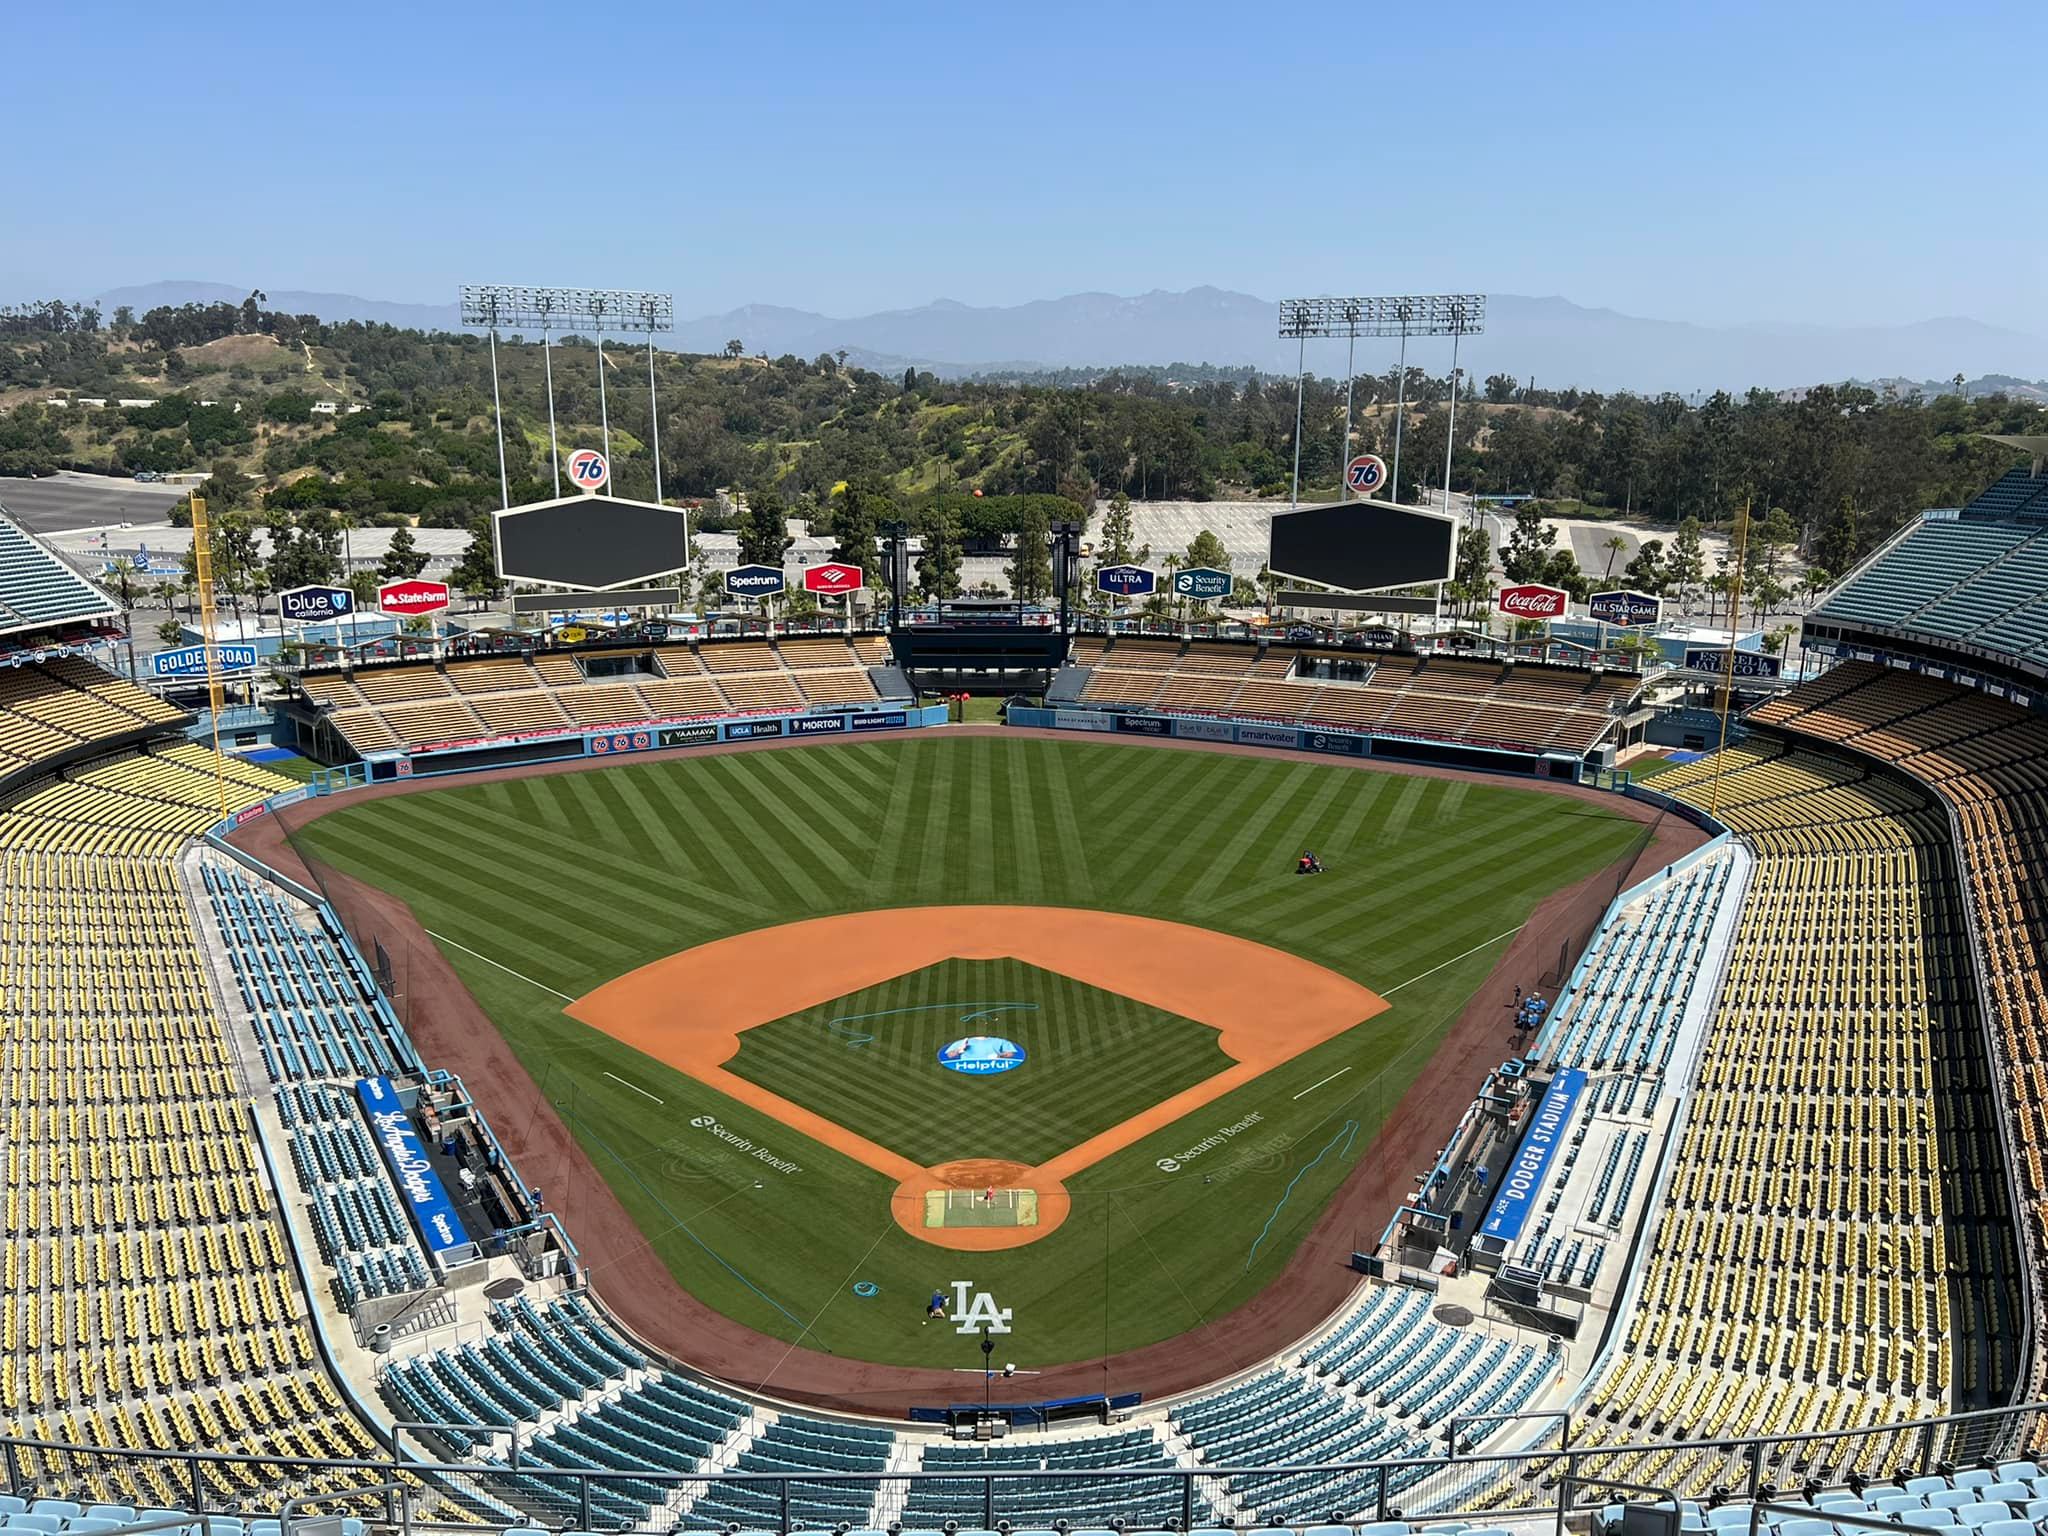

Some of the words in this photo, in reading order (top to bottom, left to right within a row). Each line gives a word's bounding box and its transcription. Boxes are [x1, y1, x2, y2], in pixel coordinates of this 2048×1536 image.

[576, 457, 604, 480] 76
[1352, 463, 1379, 485] 76
[729, 576, 777, 588] Spectrum
[1110, 575, 1142, 584] ULTRA
[1195, 575, 1226, 585] Security
[1195, 584, 1222, 592] Benefit
[288, 595, 328, 611] blue
[295, 609, 334, 618] california
[1631, 604, 1657, 615] GAME
[217, 650, 252, 664] ROAD
[1692, 660, 1752, 675] JALISCO
[802, 719, 841, 730] MORTON
[1124, 717, 1160, 728] Spectrum
[731, 727, 750, 735] UCLA
[753, 724, 778, 734] Health
[635, 736, 646, 744] 76
[1241, 728, 1296, 744] smartwater
[596, 740, 606, 749] 76
[615, 738, 627, 746] 76
[398, 763, 410, 772] 76
[955, 1061, 1009, 1071] Helpful
[1174, 1132, 1228, 1162] Security
[1218, 1111, 1264, 1137] Benefit
[382, 1127, 416, 1161] Angeles
[707, 1123, 755, 1152] Security
[751, 1147, 798, 1174] Benefit
[1506, 1146, 1546, 1200] DODGER
[1532, 1093, 1570, 1143] STADIUM
[398, 1160, 434, 1203] Dodgers
[950, 1280, 1012, 1334] LA
